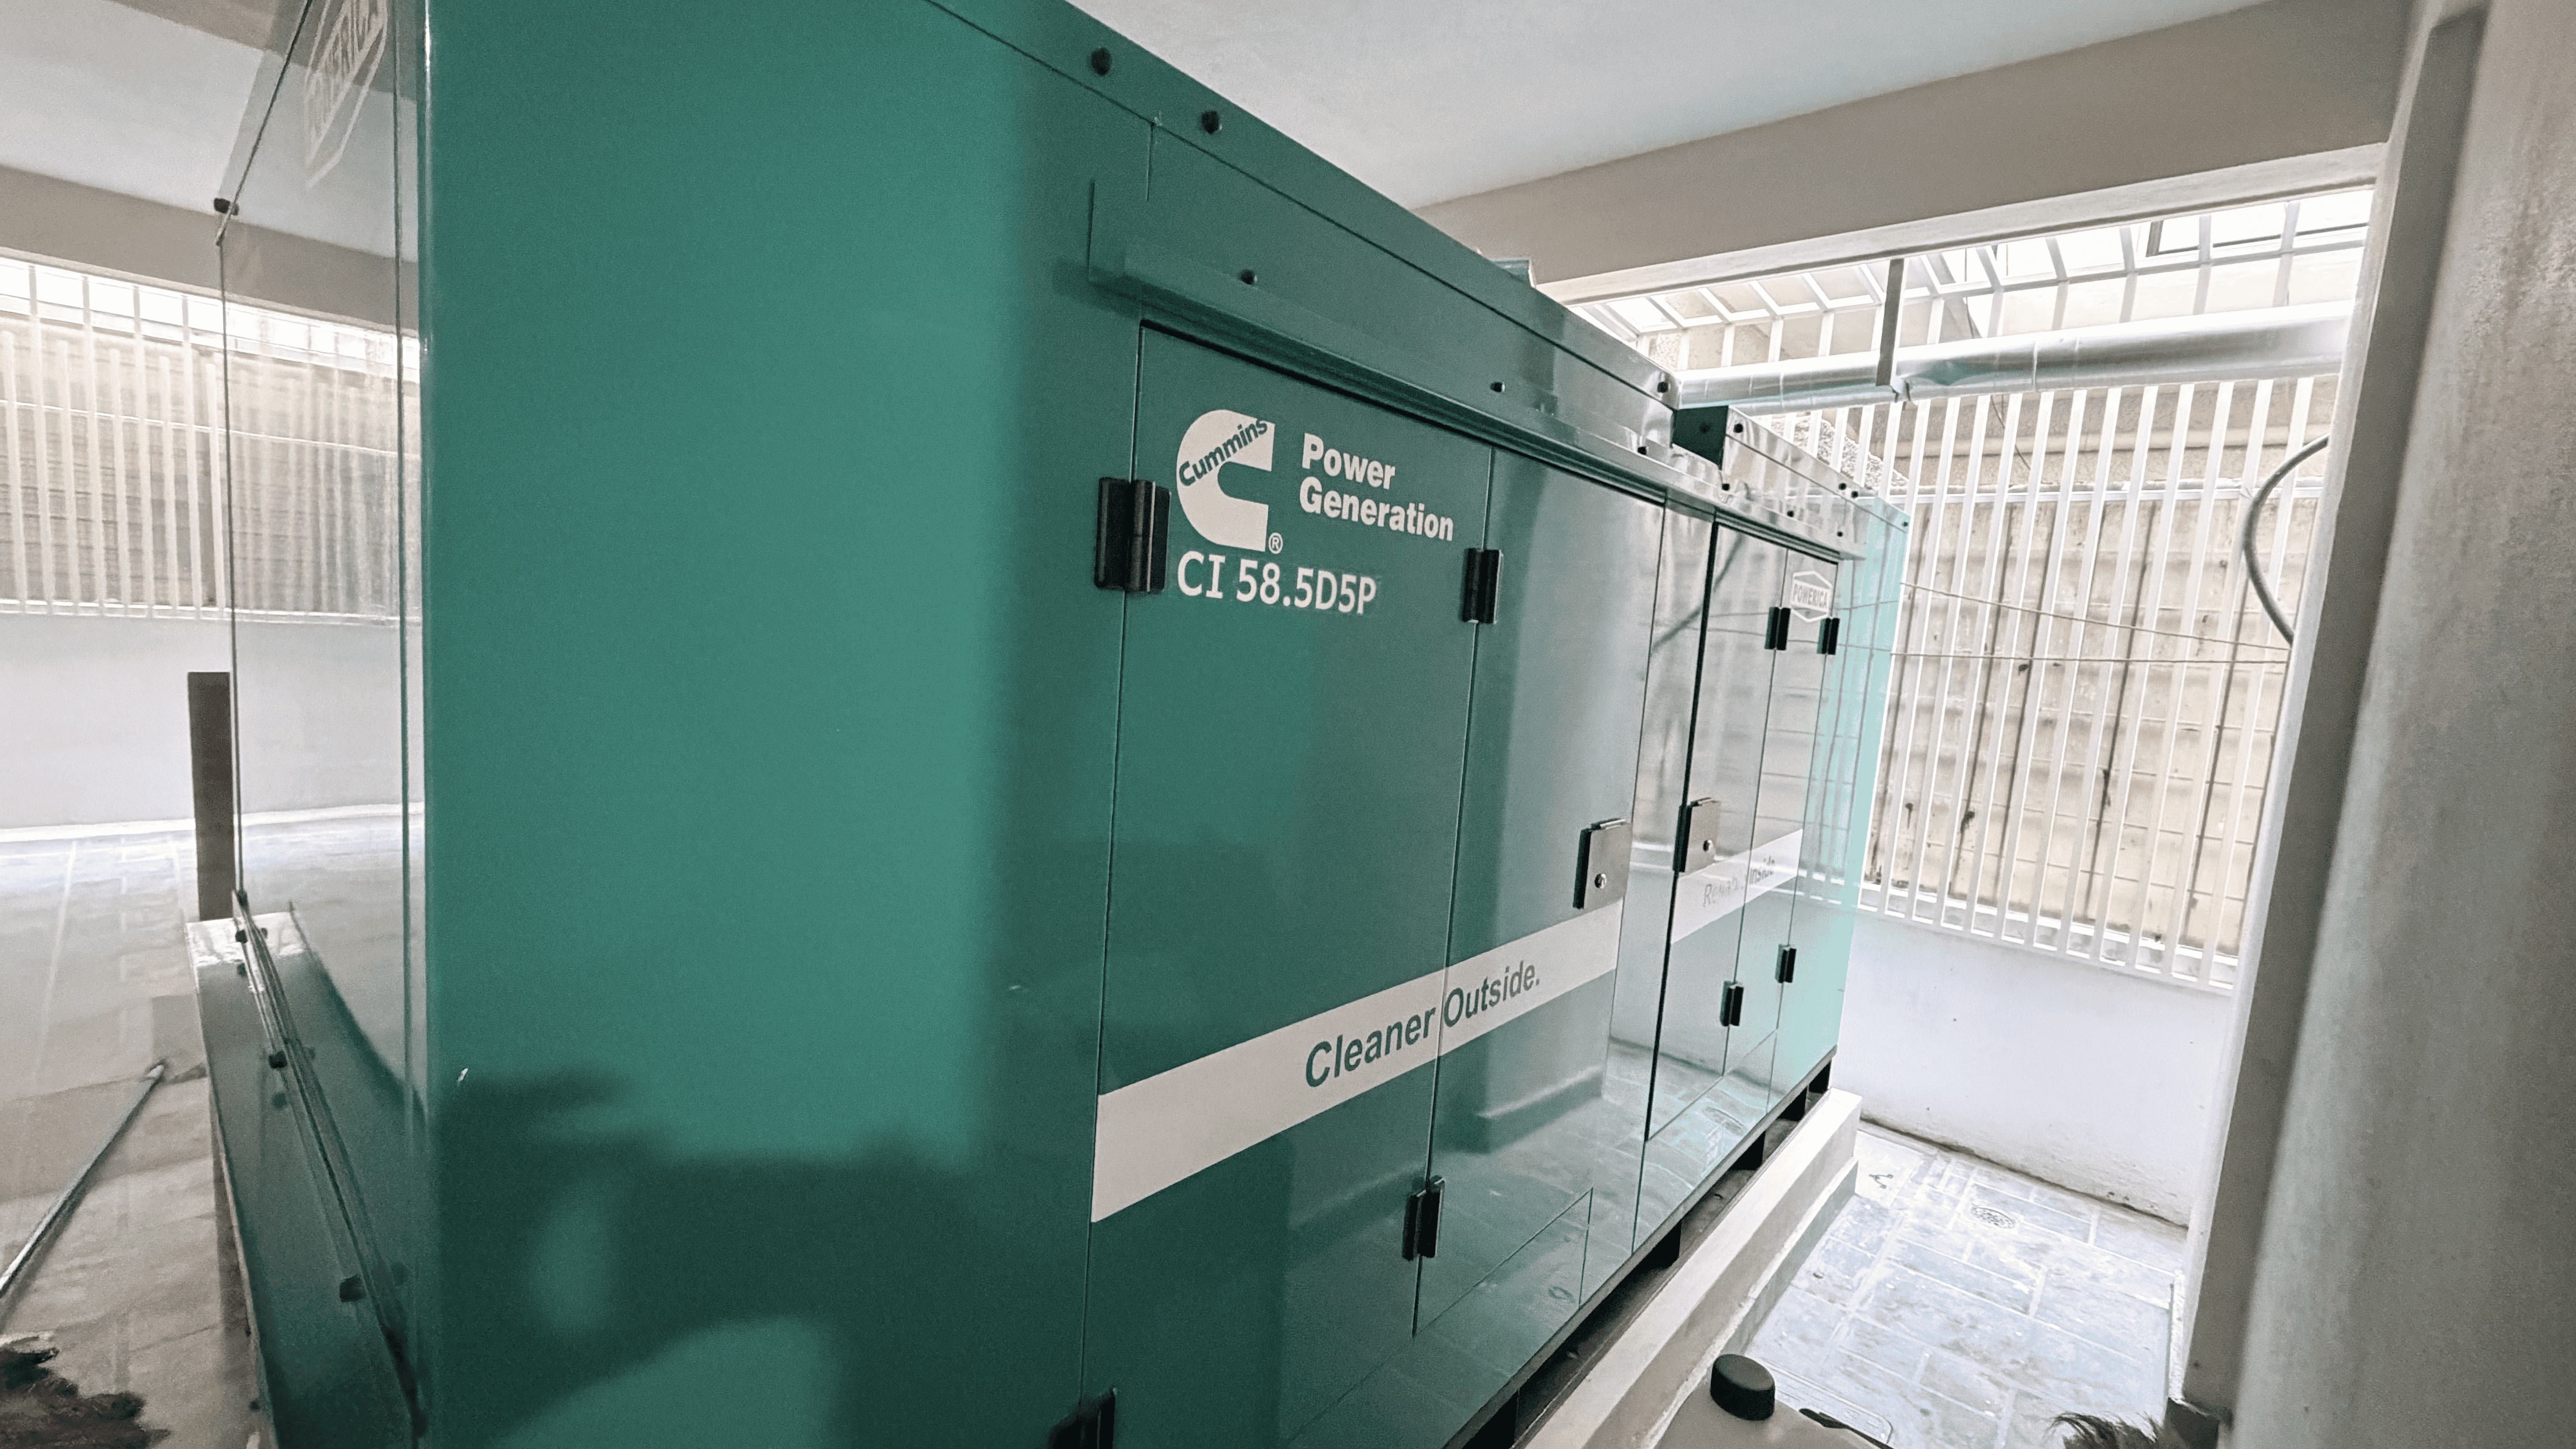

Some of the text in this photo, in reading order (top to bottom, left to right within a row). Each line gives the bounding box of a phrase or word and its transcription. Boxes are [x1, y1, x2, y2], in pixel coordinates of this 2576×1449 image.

[1178, 418, 1268, 487] Cummins
[1302, 432, 1396, 490] Power
[1299, 476, 1454, 541] Generation
[1177, 551, 1377, 615] CI 58.5D5P
[1793, 583, 1827, 608] POWERICA
[1306, 960, 1540, 1088] Cleaner Outside.
